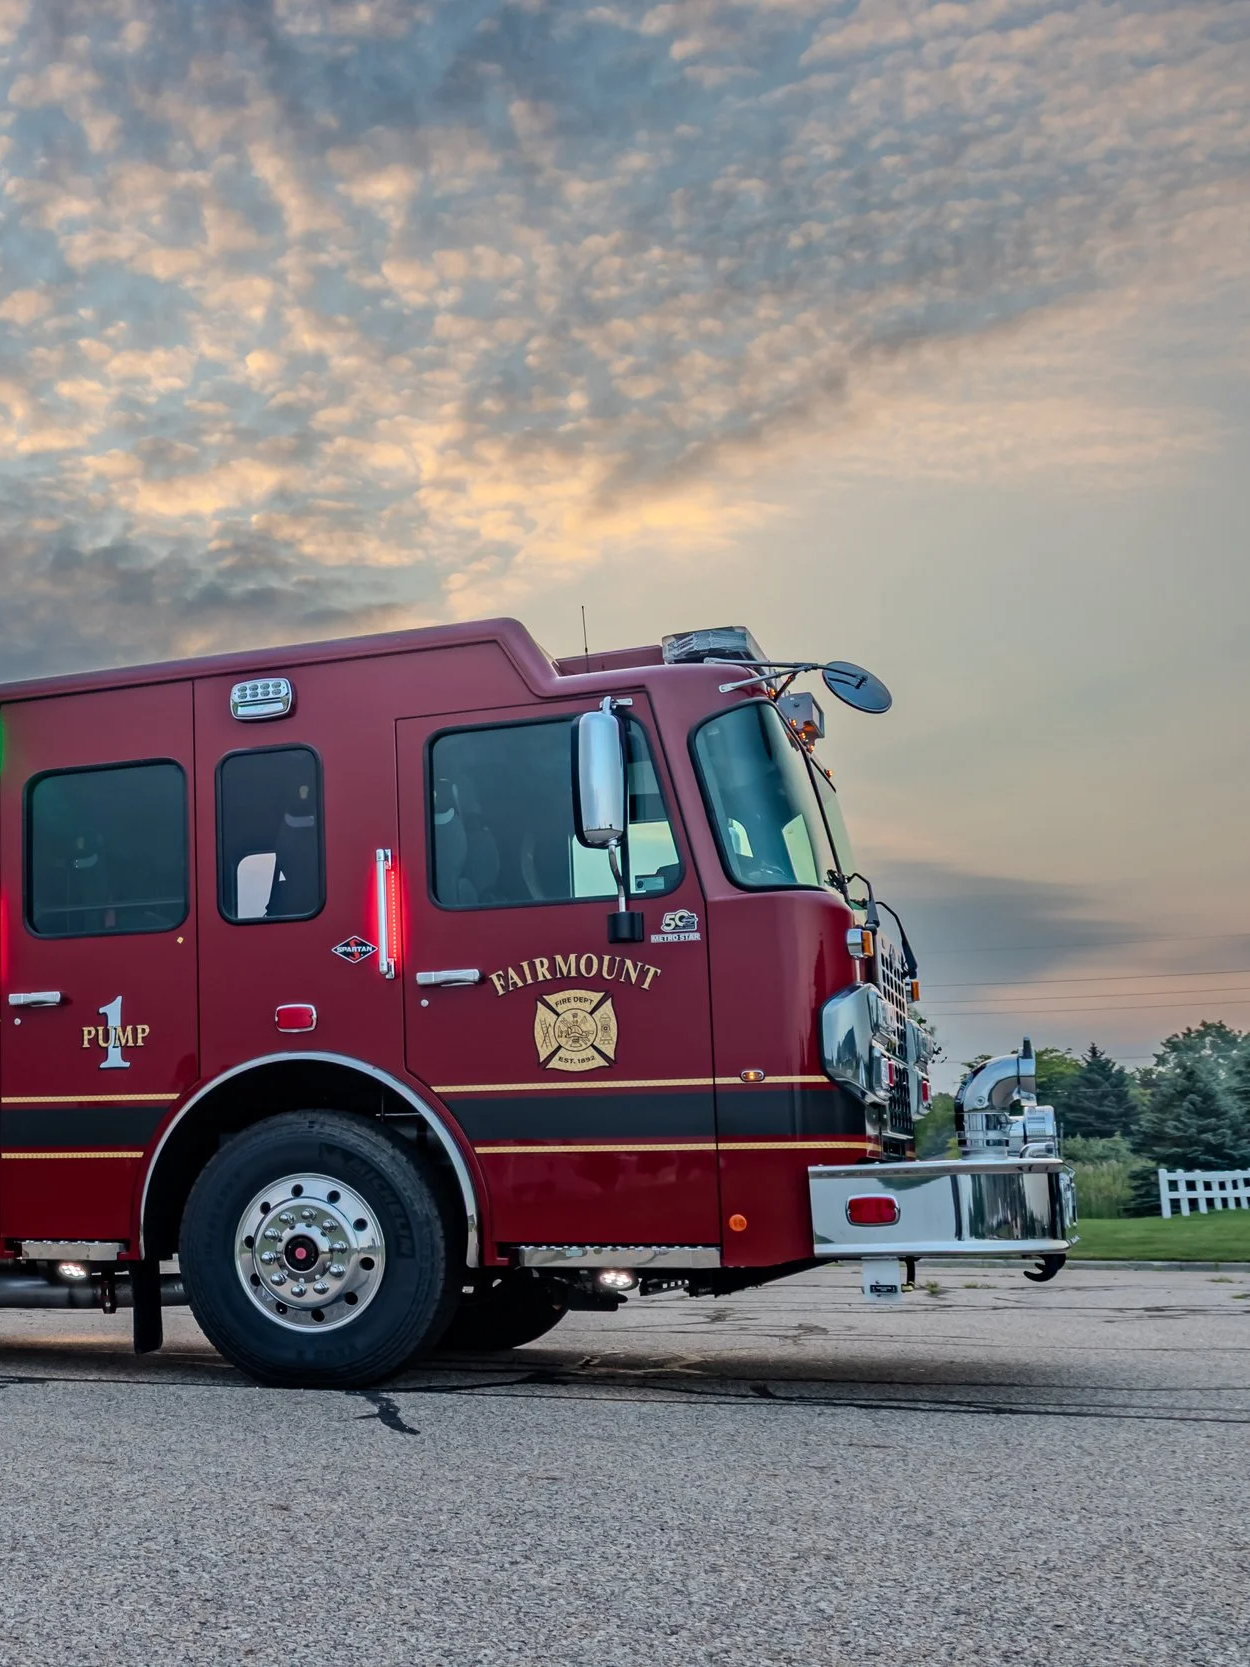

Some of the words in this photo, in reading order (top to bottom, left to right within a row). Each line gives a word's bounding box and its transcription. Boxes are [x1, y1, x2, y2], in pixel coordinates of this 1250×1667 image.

[651, 934, 679, 942] METRO
[679, 932, 700, 941] STAR
[488, 953, 662, 997] FAIRMOUNT
[555, 996, 572, 1008] FIRE
[573, 996, 594, 1006] DEPT
[81, 1024, 150, 1048] PUMP
[98, 995, 131, 1069] 1
[558, 1056, 576, 1064] EST.
[578, 1055, 596, 1064] 1892
[346, 1158, 415, 1258] MICHELIN
